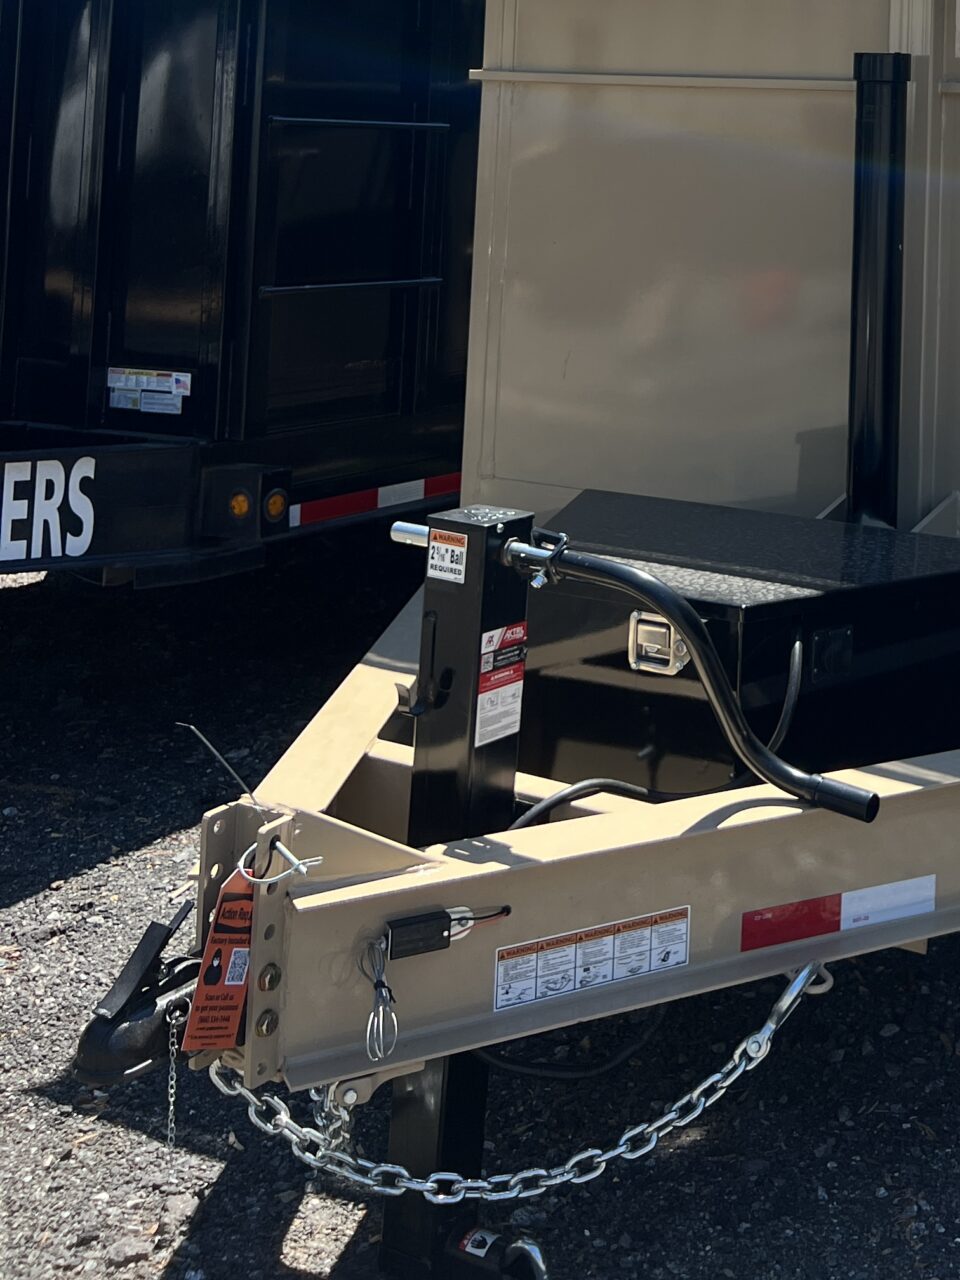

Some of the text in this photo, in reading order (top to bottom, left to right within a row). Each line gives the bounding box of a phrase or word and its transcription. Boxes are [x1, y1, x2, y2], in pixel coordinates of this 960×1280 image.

[0, 456, 96, 561] ERS
[439, 534, 465, 544] WARNING
[450, 549, 464, 565] Ball
[430, 563, 462, 575] REQUIRED
[221, 906, 239, 920] Action
[659, 910, 688, 923] WARNING
[622, 919, 650, 931] WARNING
[584, 927, 614, 940] WARNING
[544, 935, 576, 949] WARNING
[506, 945, 537, 958] WARNING
